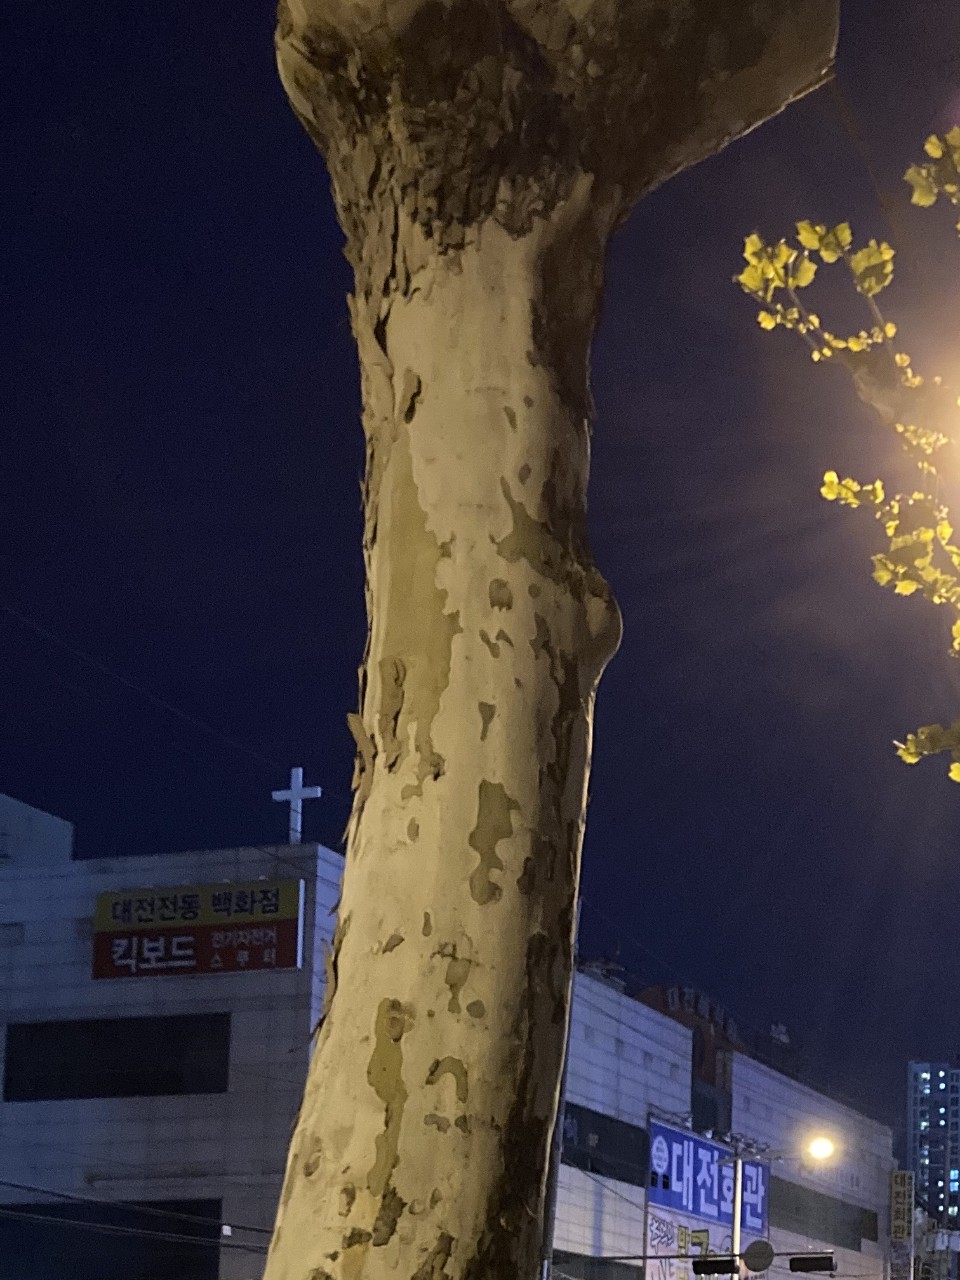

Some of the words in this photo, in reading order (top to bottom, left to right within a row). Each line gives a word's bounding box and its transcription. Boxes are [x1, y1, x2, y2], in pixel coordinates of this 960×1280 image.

[111, 893, 200, 924] 대전전동
[212, 888, 280, 917] 백화점
[111, 935, 198, 973] 킥보드
[672, 1139, 765, 1229] 대전회관
